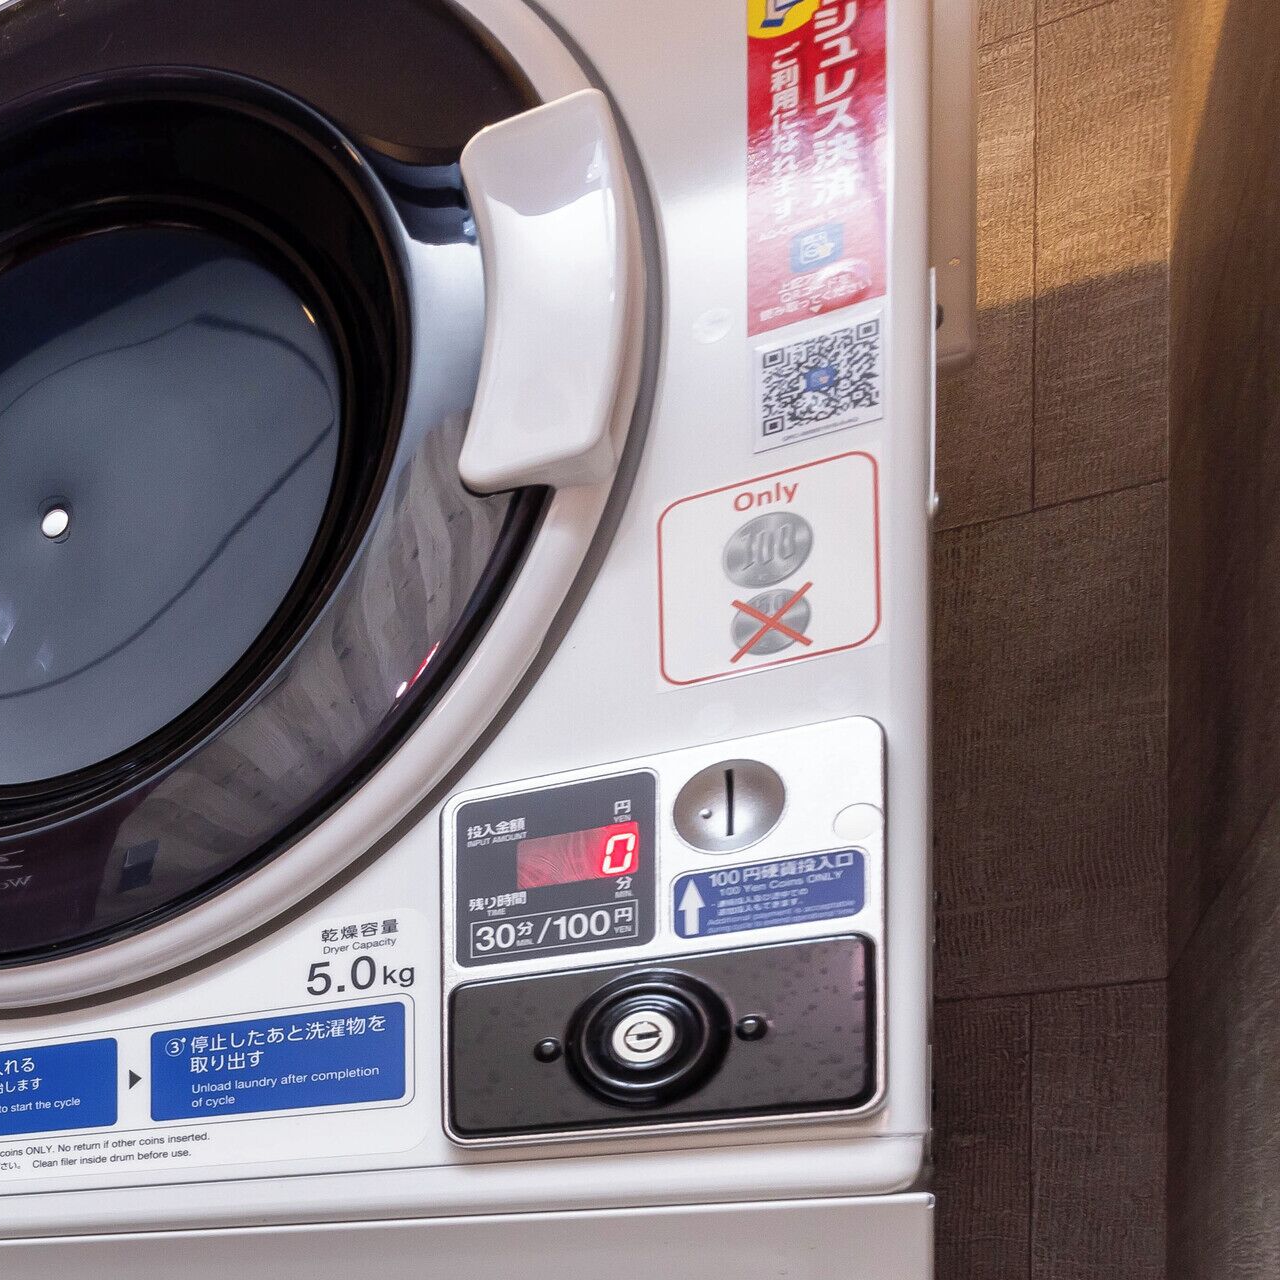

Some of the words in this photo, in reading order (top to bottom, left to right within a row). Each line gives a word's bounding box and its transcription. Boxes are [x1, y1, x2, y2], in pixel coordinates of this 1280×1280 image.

[733, 479, 800, 513] Only
[614, 799, 632, 815] 円
[467, 817, 525, 838] 投入金額
[602, 832, 636, 874] 0
[617, 876, 632, 891] 分
[469, 891, 527, 912] 残り時間
[321, 918, 399, 943] 乾燥容量
[323, 944, 349, 955] Dryer
[352, 936, 396, 953] Capacity
[191, 1014, 386, 1054] 停止したあと洗濯物を
[190, 1050, 264, 1074] 取り出す
[191, 1080, 231, 1094] Unload
[234, 1076, 277, 1092] laundry
[281, 1072, 309, 1086] after
[311, 1065, 379, 1084] completion
[10, 1102, 33, 1113] start
[35, 1100, 52, 1110] the
[54, 1097, 81, 1111] cycle
[191, 1097, 204, 1108] of
[205, 1095, 235, 1108] cycle
[32, 1158, 58, 1169] Clean
[60, 1156, 78, 1166] filer
[80, 1154, 107, 1165] inside
[110, 1152, 135, 1163] drum
[137, 1150, 169, 1160] before
[171, 1150, 192, 1159] use.
